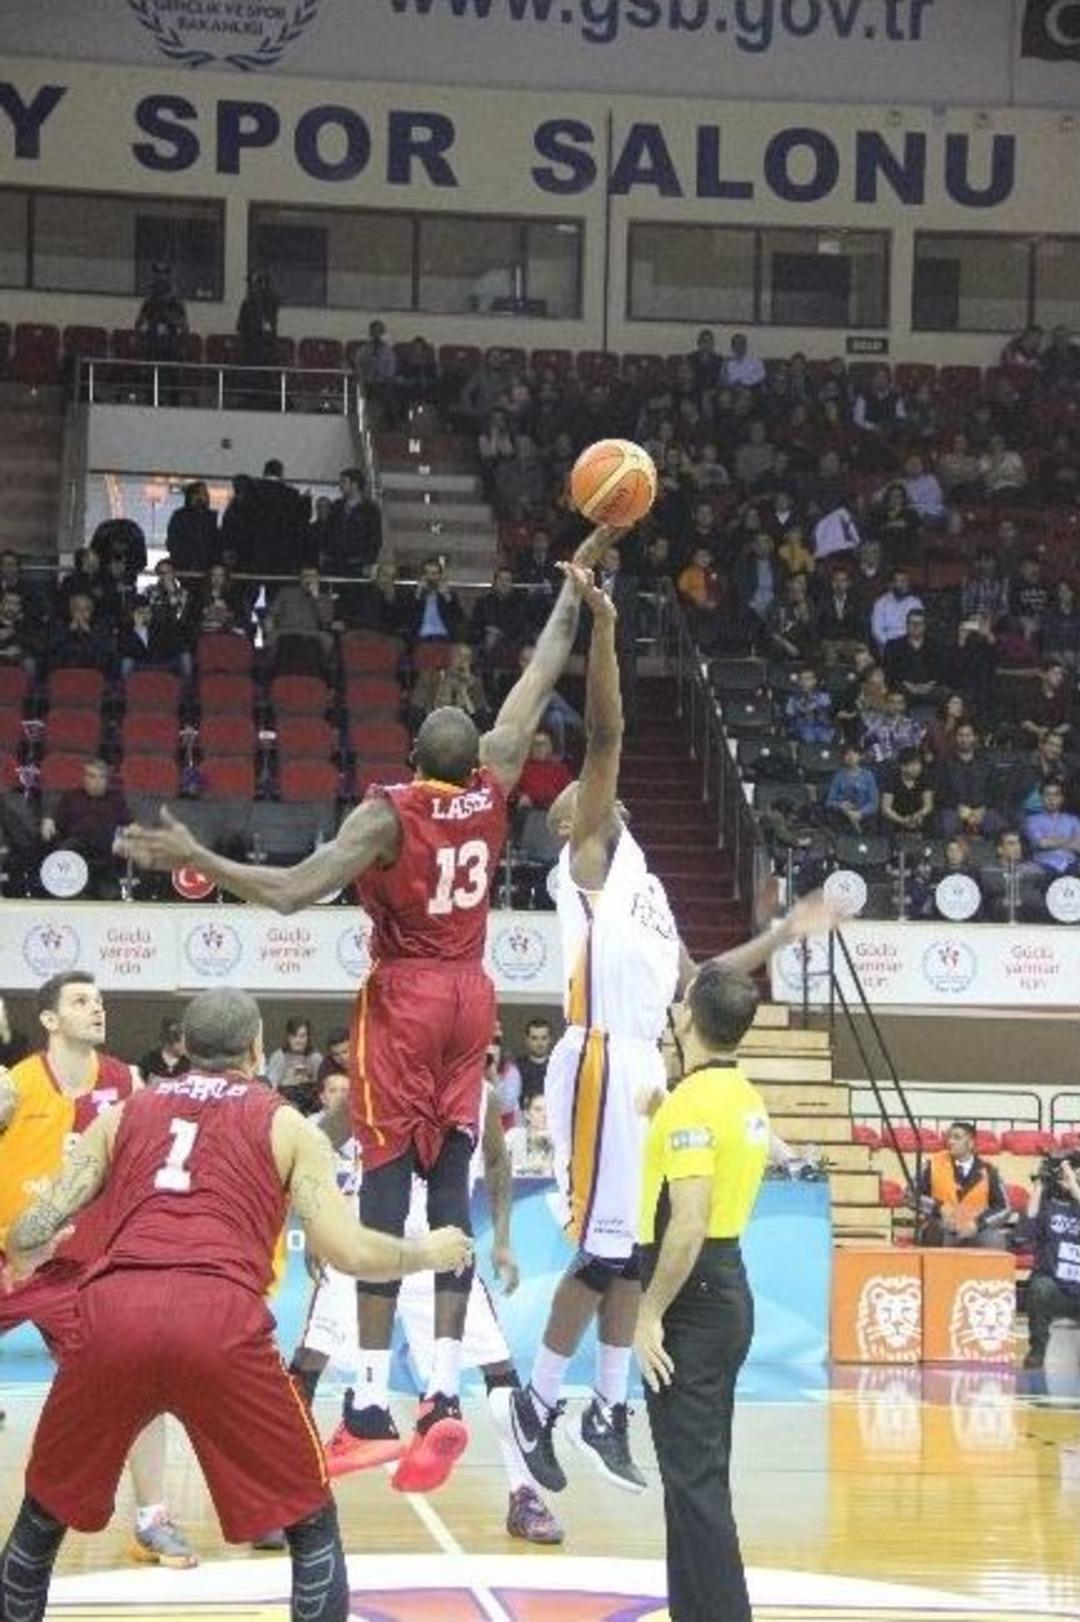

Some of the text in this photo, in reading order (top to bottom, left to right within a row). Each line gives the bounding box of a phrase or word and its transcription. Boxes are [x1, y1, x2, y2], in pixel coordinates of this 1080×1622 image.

[132, 94, 458, 187] SPOR
[531, 118, 1016, 208] SALONU
[428, 839, 490, 914] 13
[154, 1117, 199, 1194] 1
